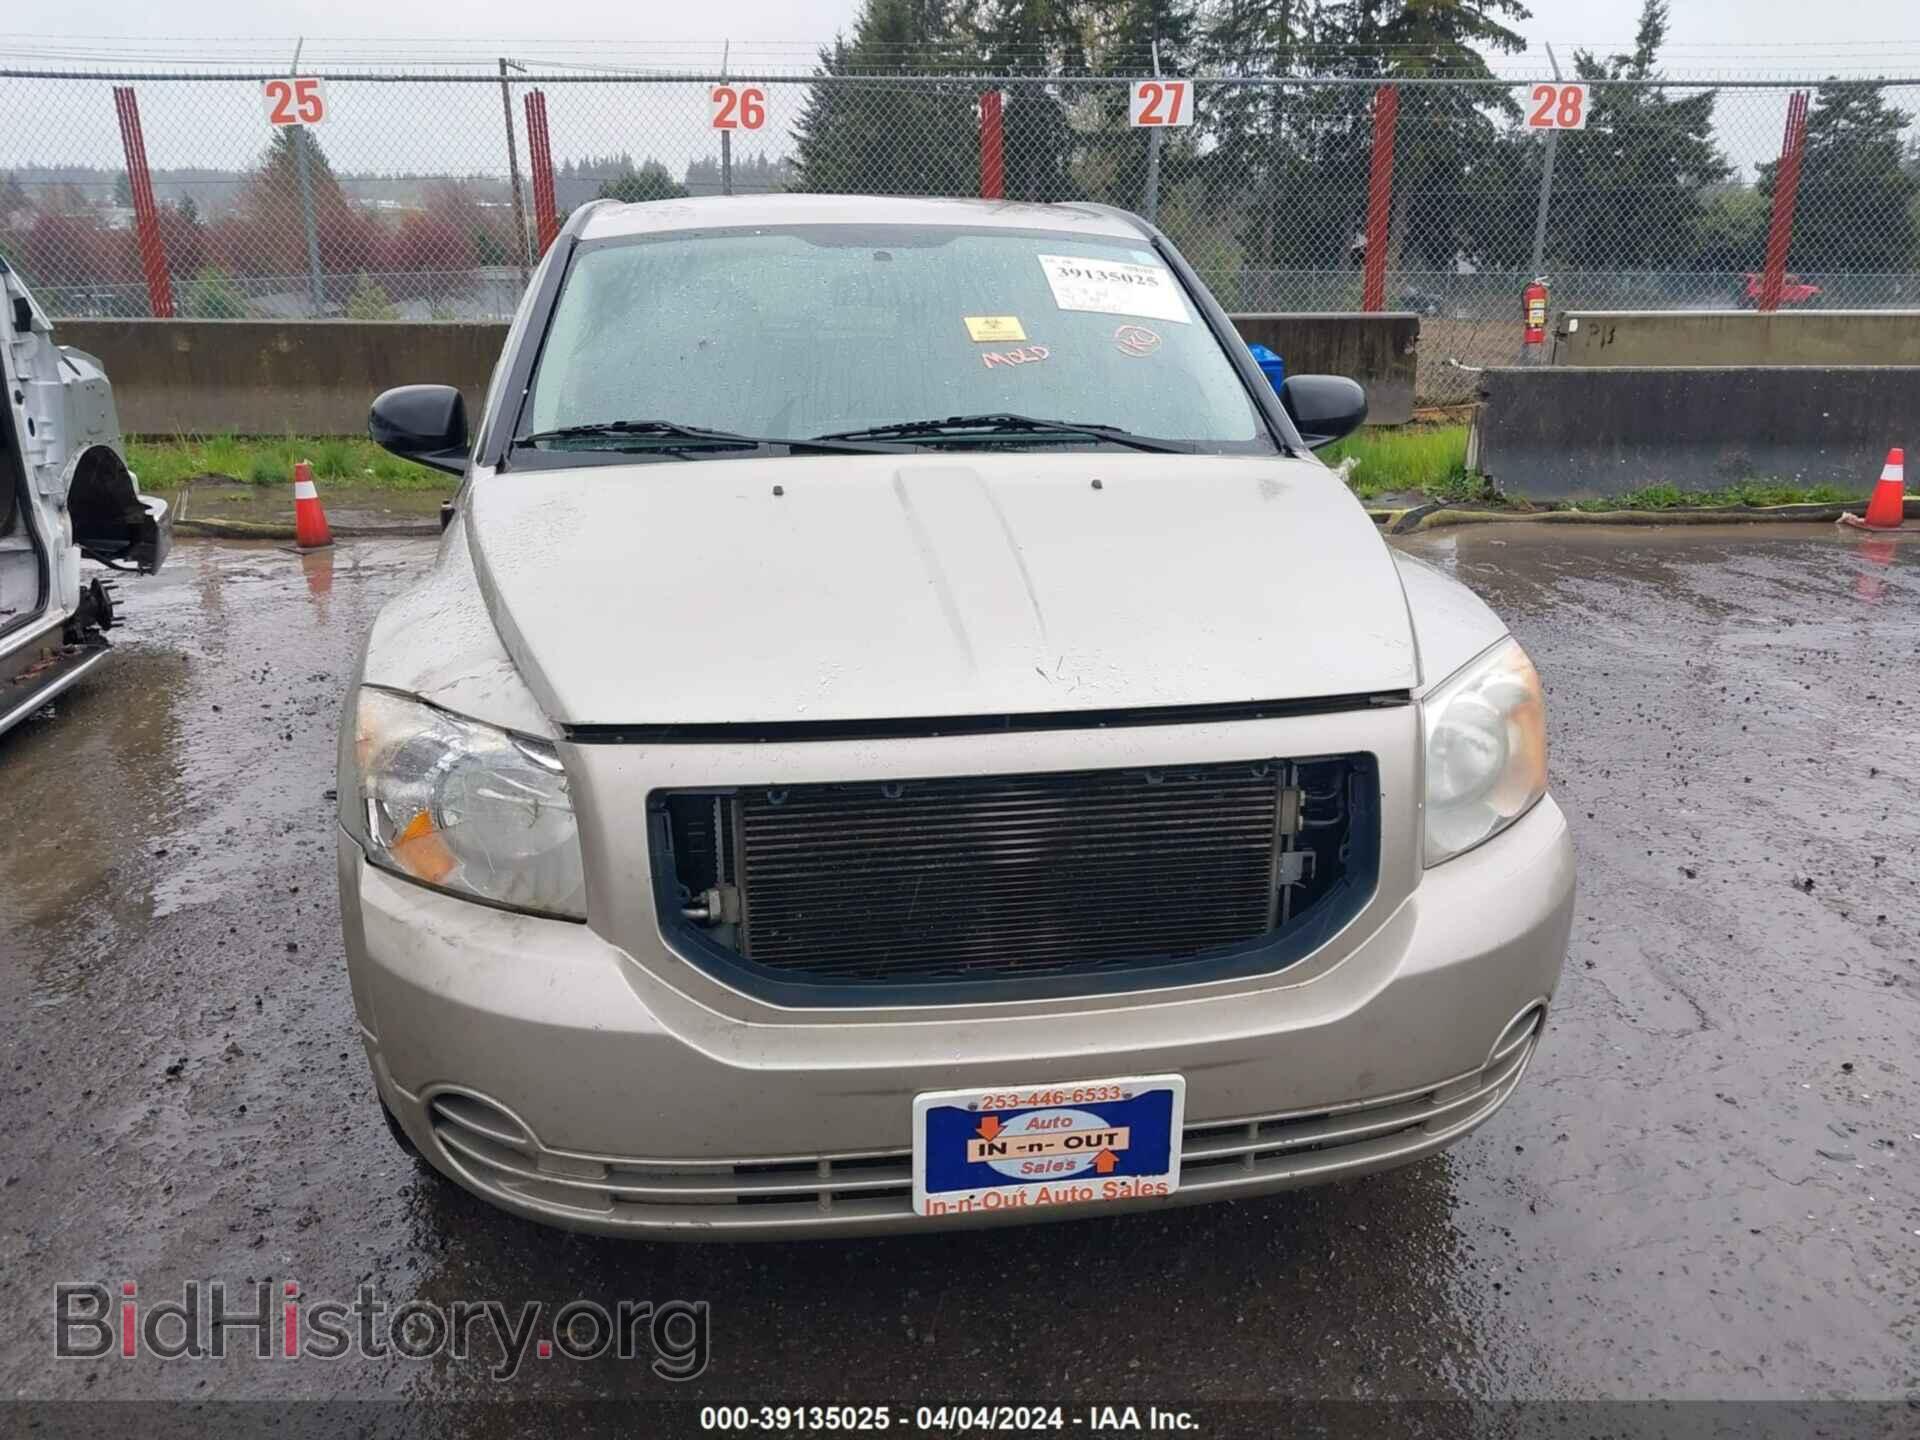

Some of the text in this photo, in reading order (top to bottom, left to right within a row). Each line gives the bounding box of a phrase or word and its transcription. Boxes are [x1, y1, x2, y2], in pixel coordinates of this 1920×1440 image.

[266, 80, 323, 123] 25
[713, 87, 765, 129] 26
[1138, 83, 1185, 124] 27
[1529, 85, 1583, 128] 28
[1057, 266, 1160, 287] 39135025
[982, 1086, 1120, 1110] 253-446-6533
[1025, 1116, 1073, 1131] Auto
[978, 1142, 1007, 1157] IN
[1063, 1132, 1119, 1149] OUT
[1020, 1159, 1077, 1175] Sales
[924, 1178, 1169, 1216] In-n-Out Auto Sales
